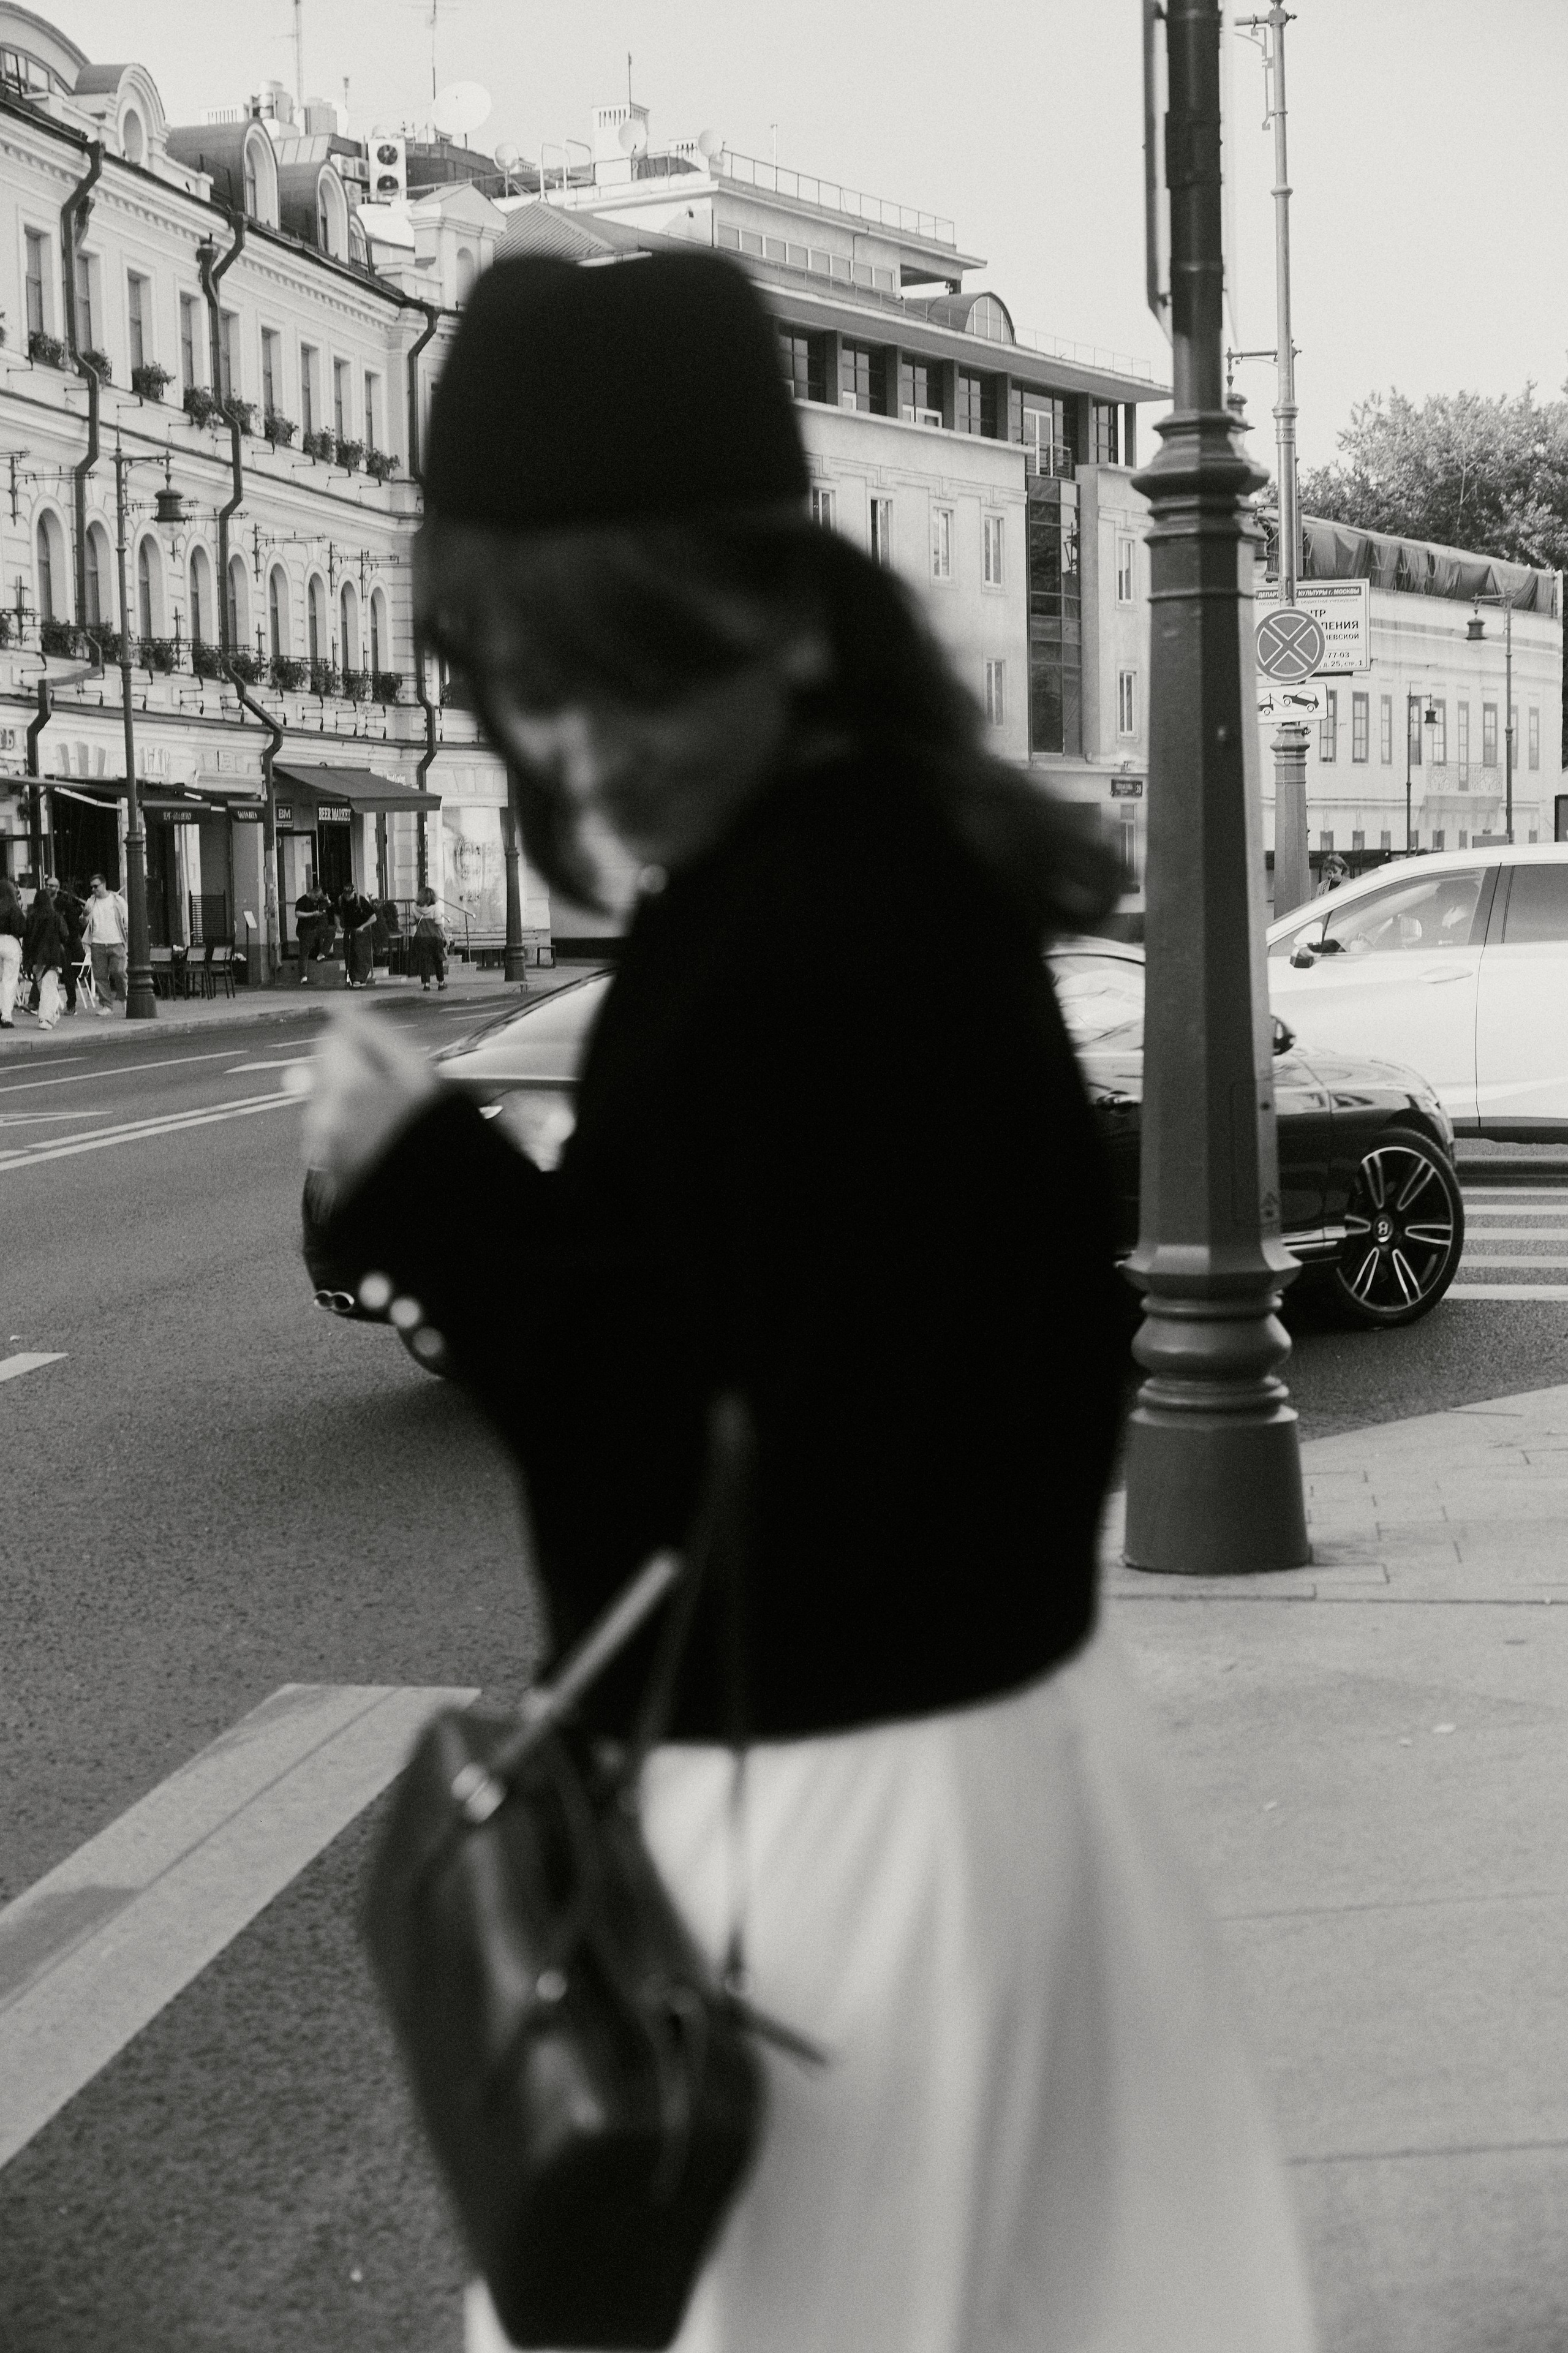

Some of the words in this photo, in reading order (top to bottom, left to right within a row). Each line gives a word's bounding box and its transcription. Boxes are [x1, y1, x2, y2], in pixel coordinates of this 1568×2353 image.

[278, 809, 291, 819] BM
[318, 807, 331, 820] BEER
[331, 807, 351, 821] MARKET
